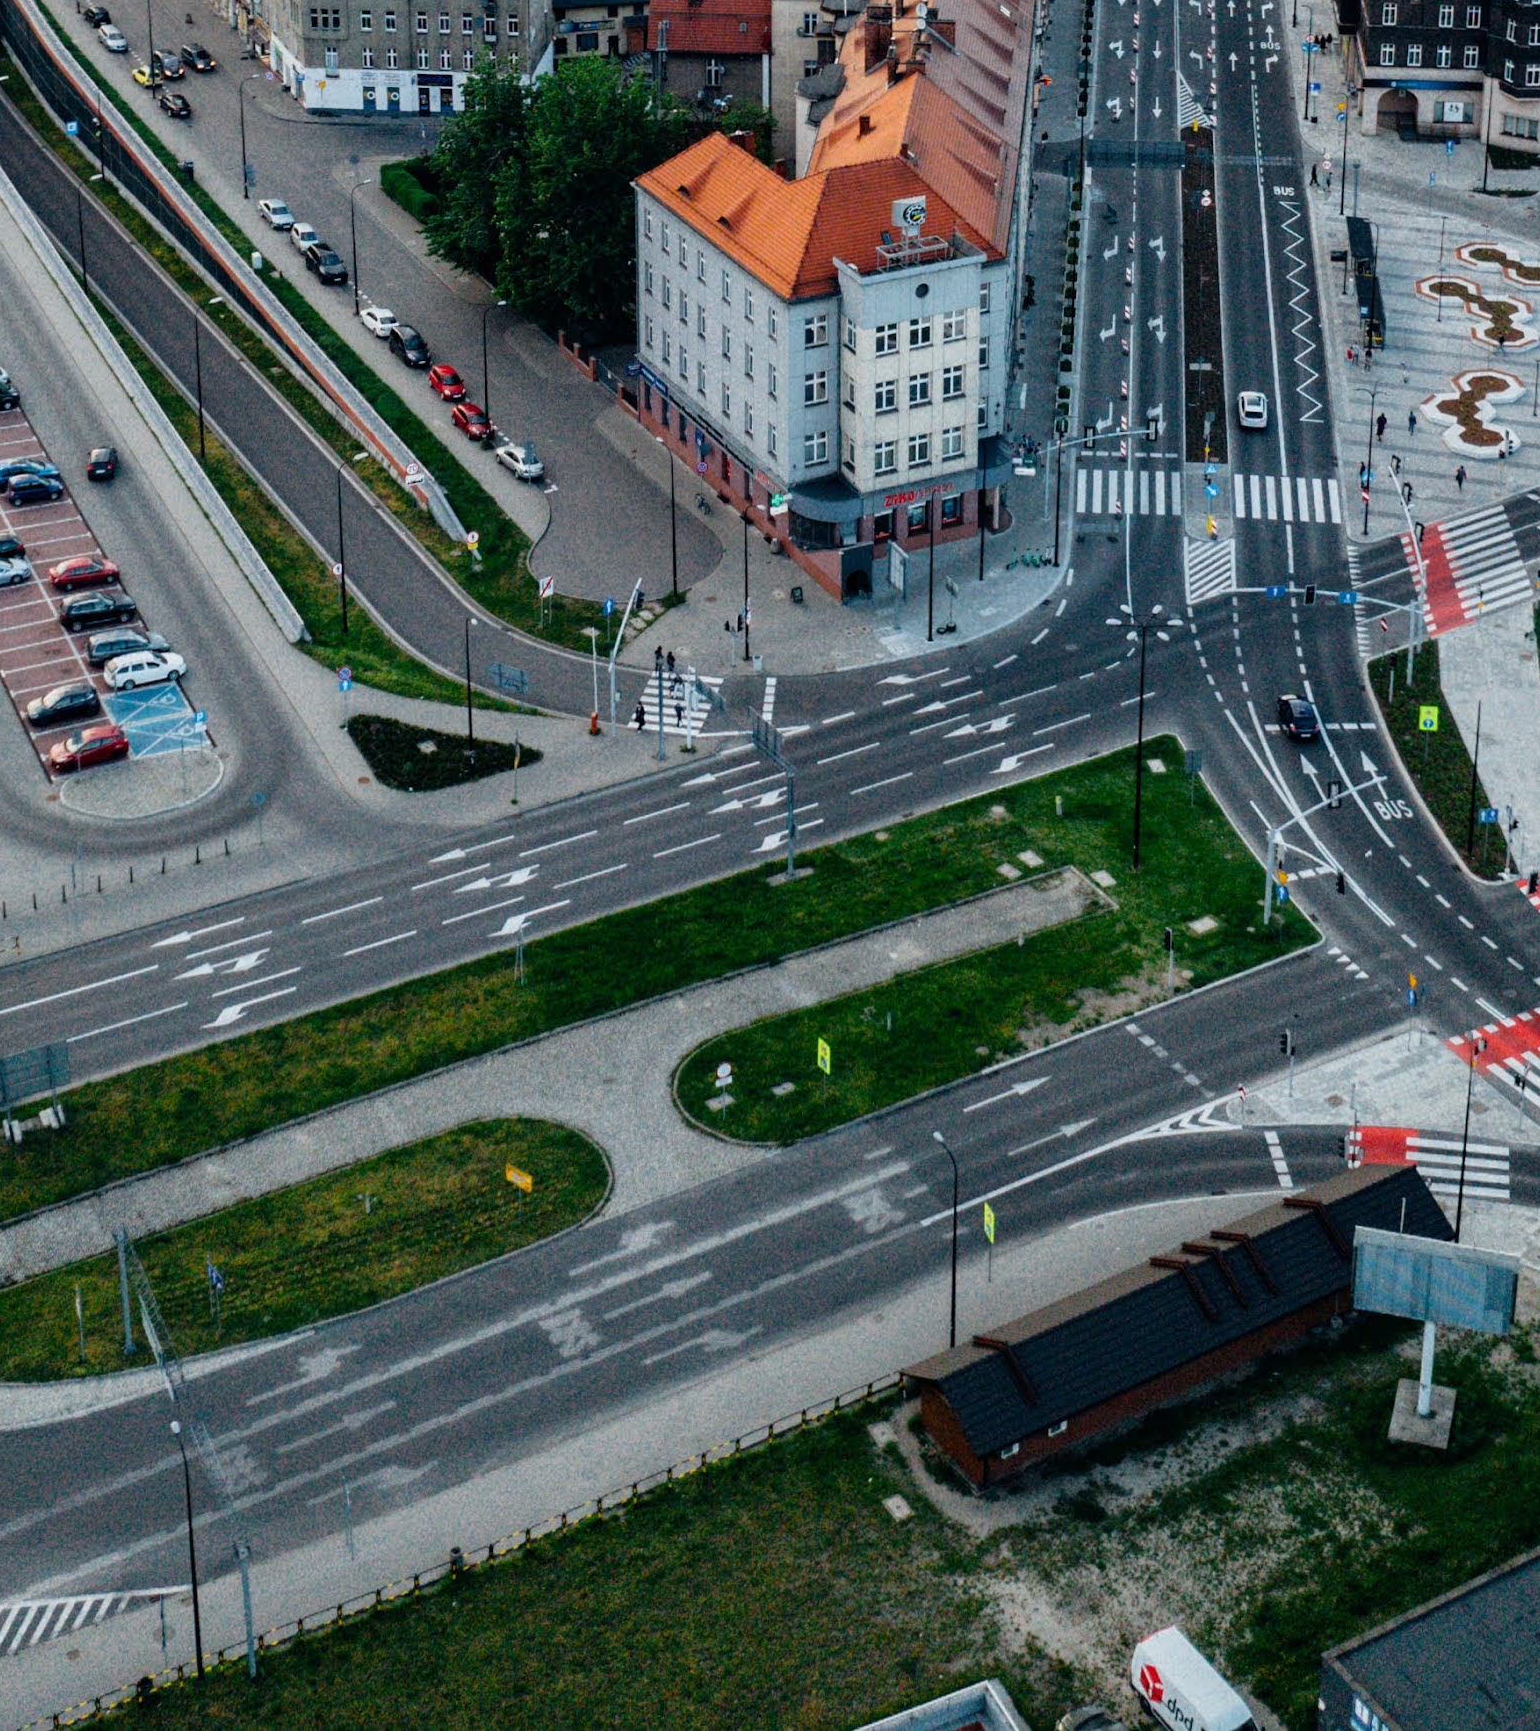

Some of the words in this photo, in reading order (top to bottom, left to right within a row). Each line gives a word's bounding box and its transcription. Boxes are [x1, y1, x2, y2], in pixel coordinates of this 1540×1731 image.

[1260, 41, 1281, 51] BUS
[1273, 185, 1295, 196] BUS
[884, 491, 915, 507] ZIKO
[1373, 799, 1413, 820] BUS
[1167, 1698, 1194, 1731] dpd
